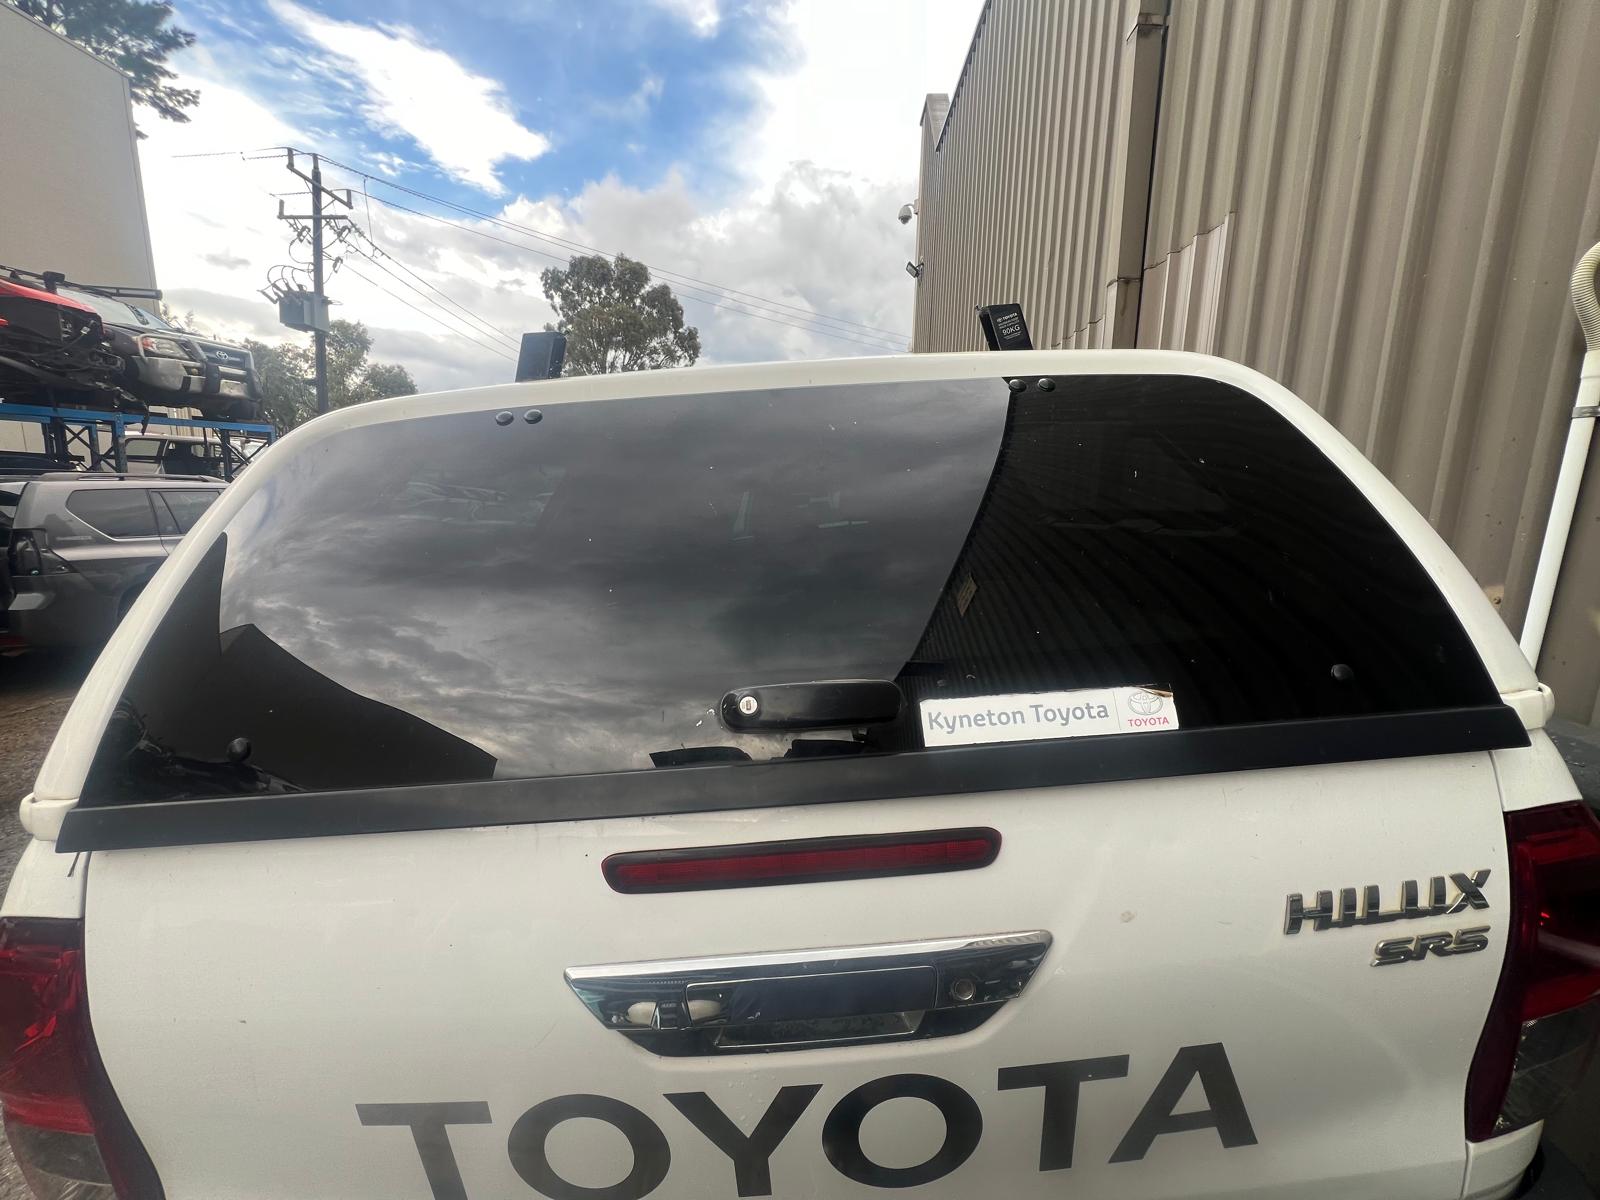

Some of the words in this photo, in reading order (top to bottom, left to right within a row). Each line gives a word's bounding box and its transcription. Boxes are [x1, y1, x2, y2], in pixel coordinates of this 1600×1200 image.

[1002, 325, 1020, 335] 90KG
[928, 707, 1025, 734] Kyneton
[1029, 702, 1109, 726] Toyota
[1128, 716, 1170, 727] TOYOTA
[1283, 868, 1491, 935] HILUX
[1370, 925, 1491, 967] SR5
[355, 1041, 1258, 1200] TOYOTA
